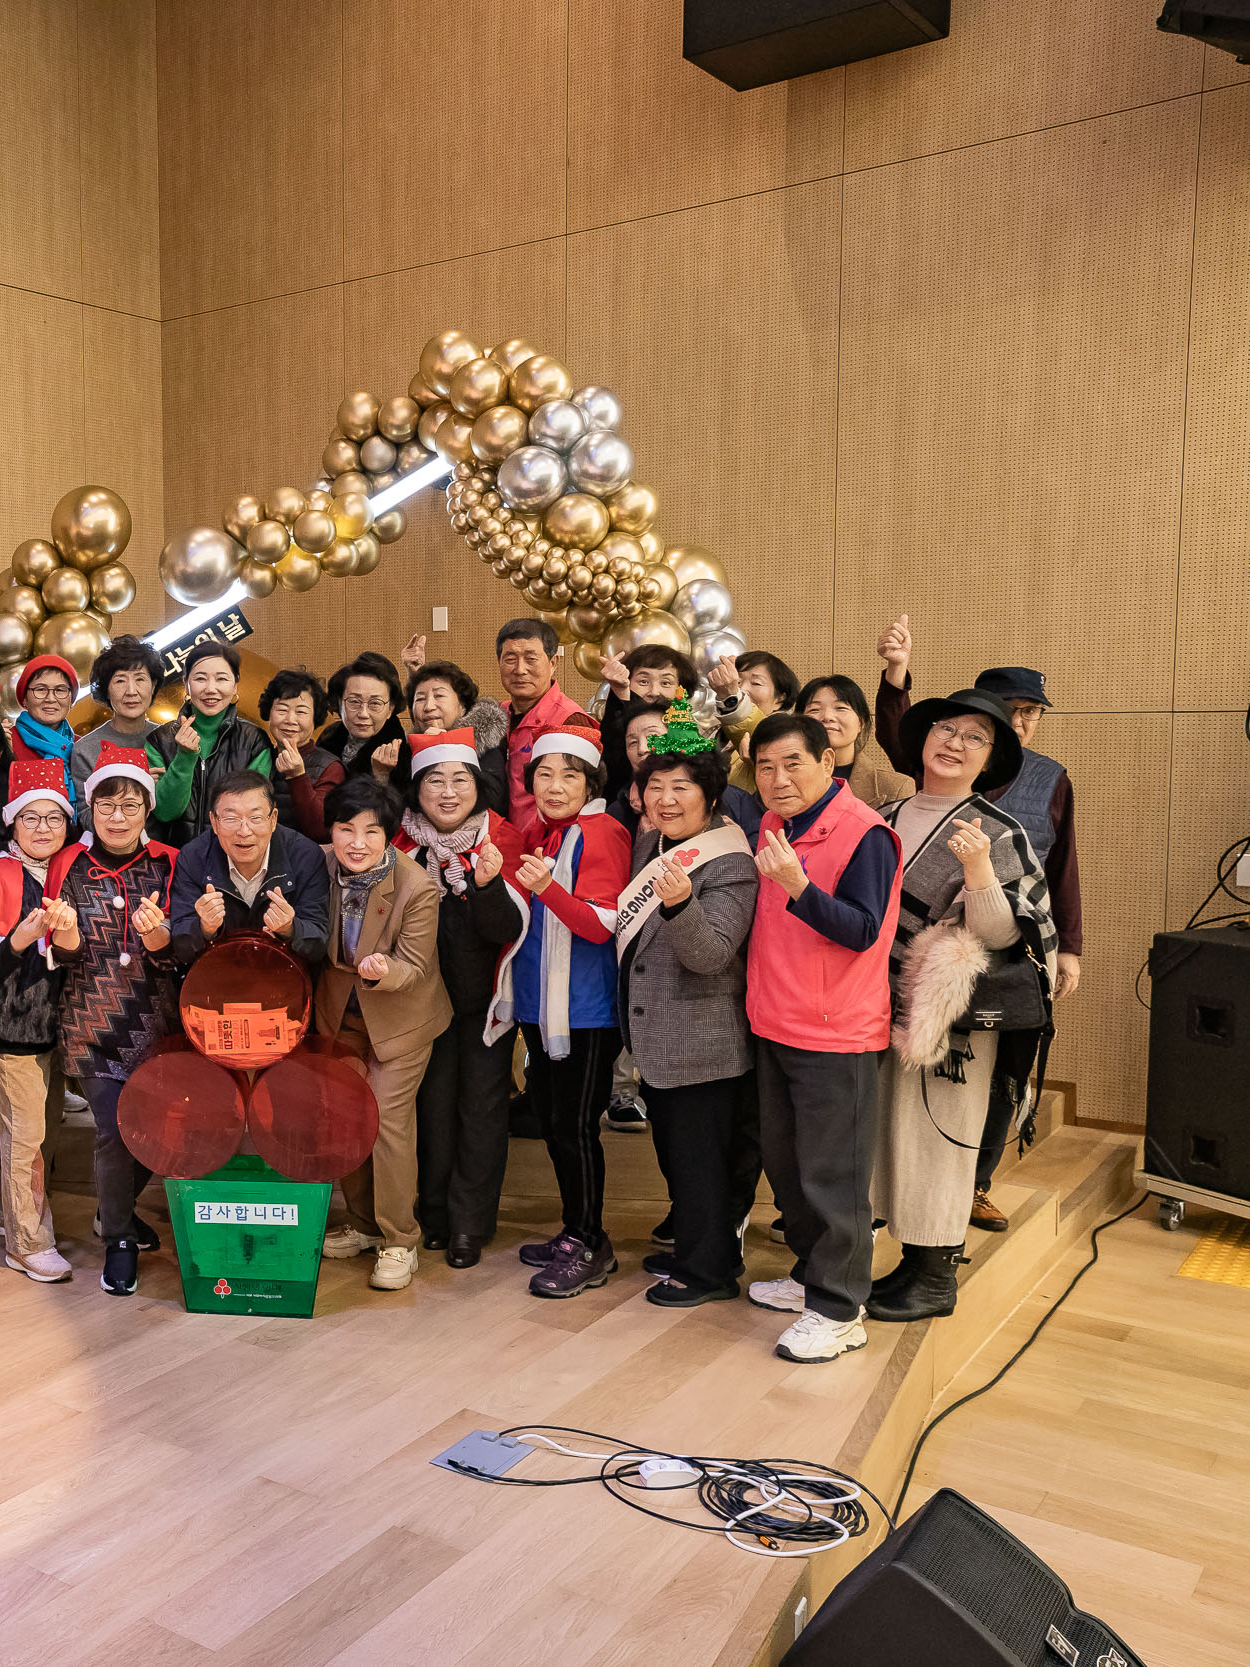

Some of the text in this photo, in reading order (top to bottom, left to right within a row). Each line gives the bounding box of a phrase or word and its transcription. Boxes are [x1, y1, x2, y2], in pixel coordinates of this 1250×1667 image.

[216, 613, 247, 641] 날
[223, 1020, 233, 1049] 따뜻한
[198, 1205, 295, 1221] 감사합니다!
